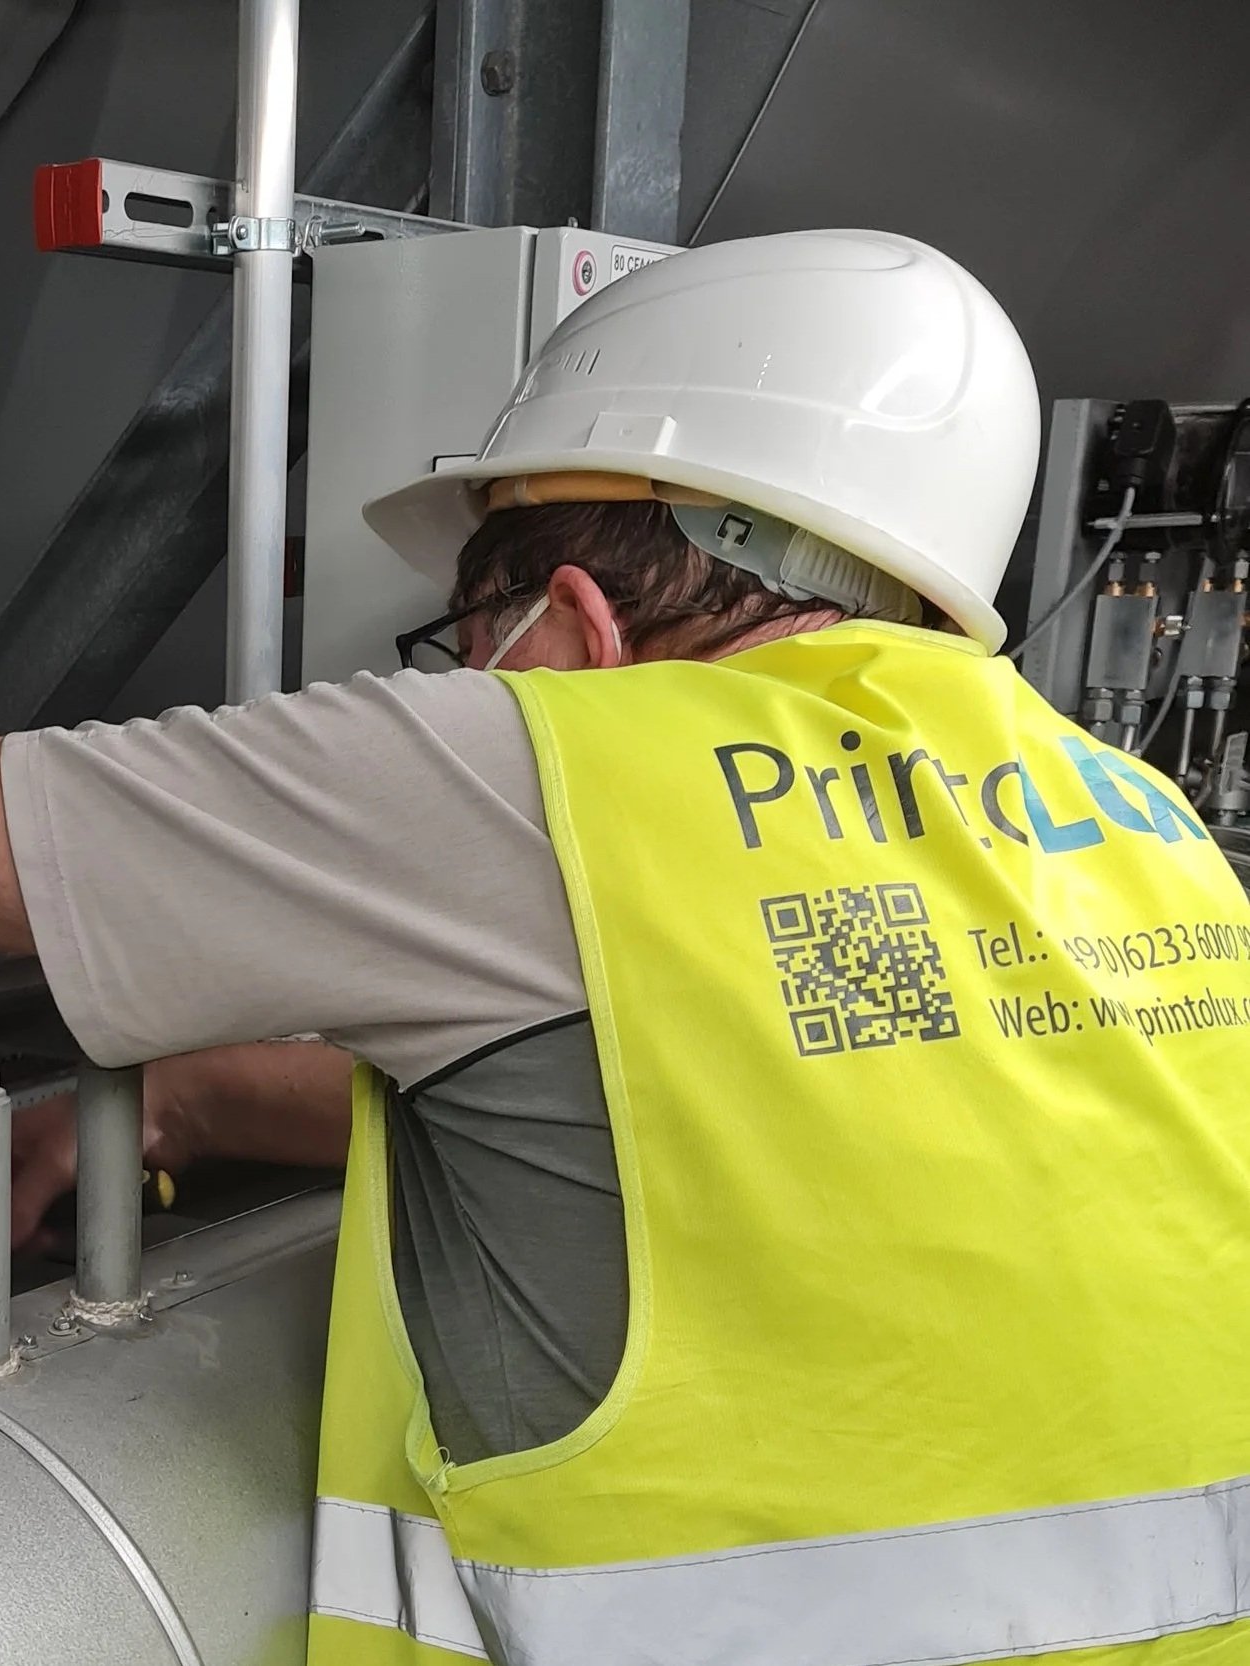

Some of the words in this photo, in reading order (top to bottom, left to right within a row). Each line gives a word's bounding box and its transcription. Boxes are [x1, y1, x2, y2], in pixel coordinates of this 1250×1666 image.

[614, 254, 625, 271] 80
[968, 922, 1049, 970] Tel.:
[989, 990, 1084, 1039] Web:
